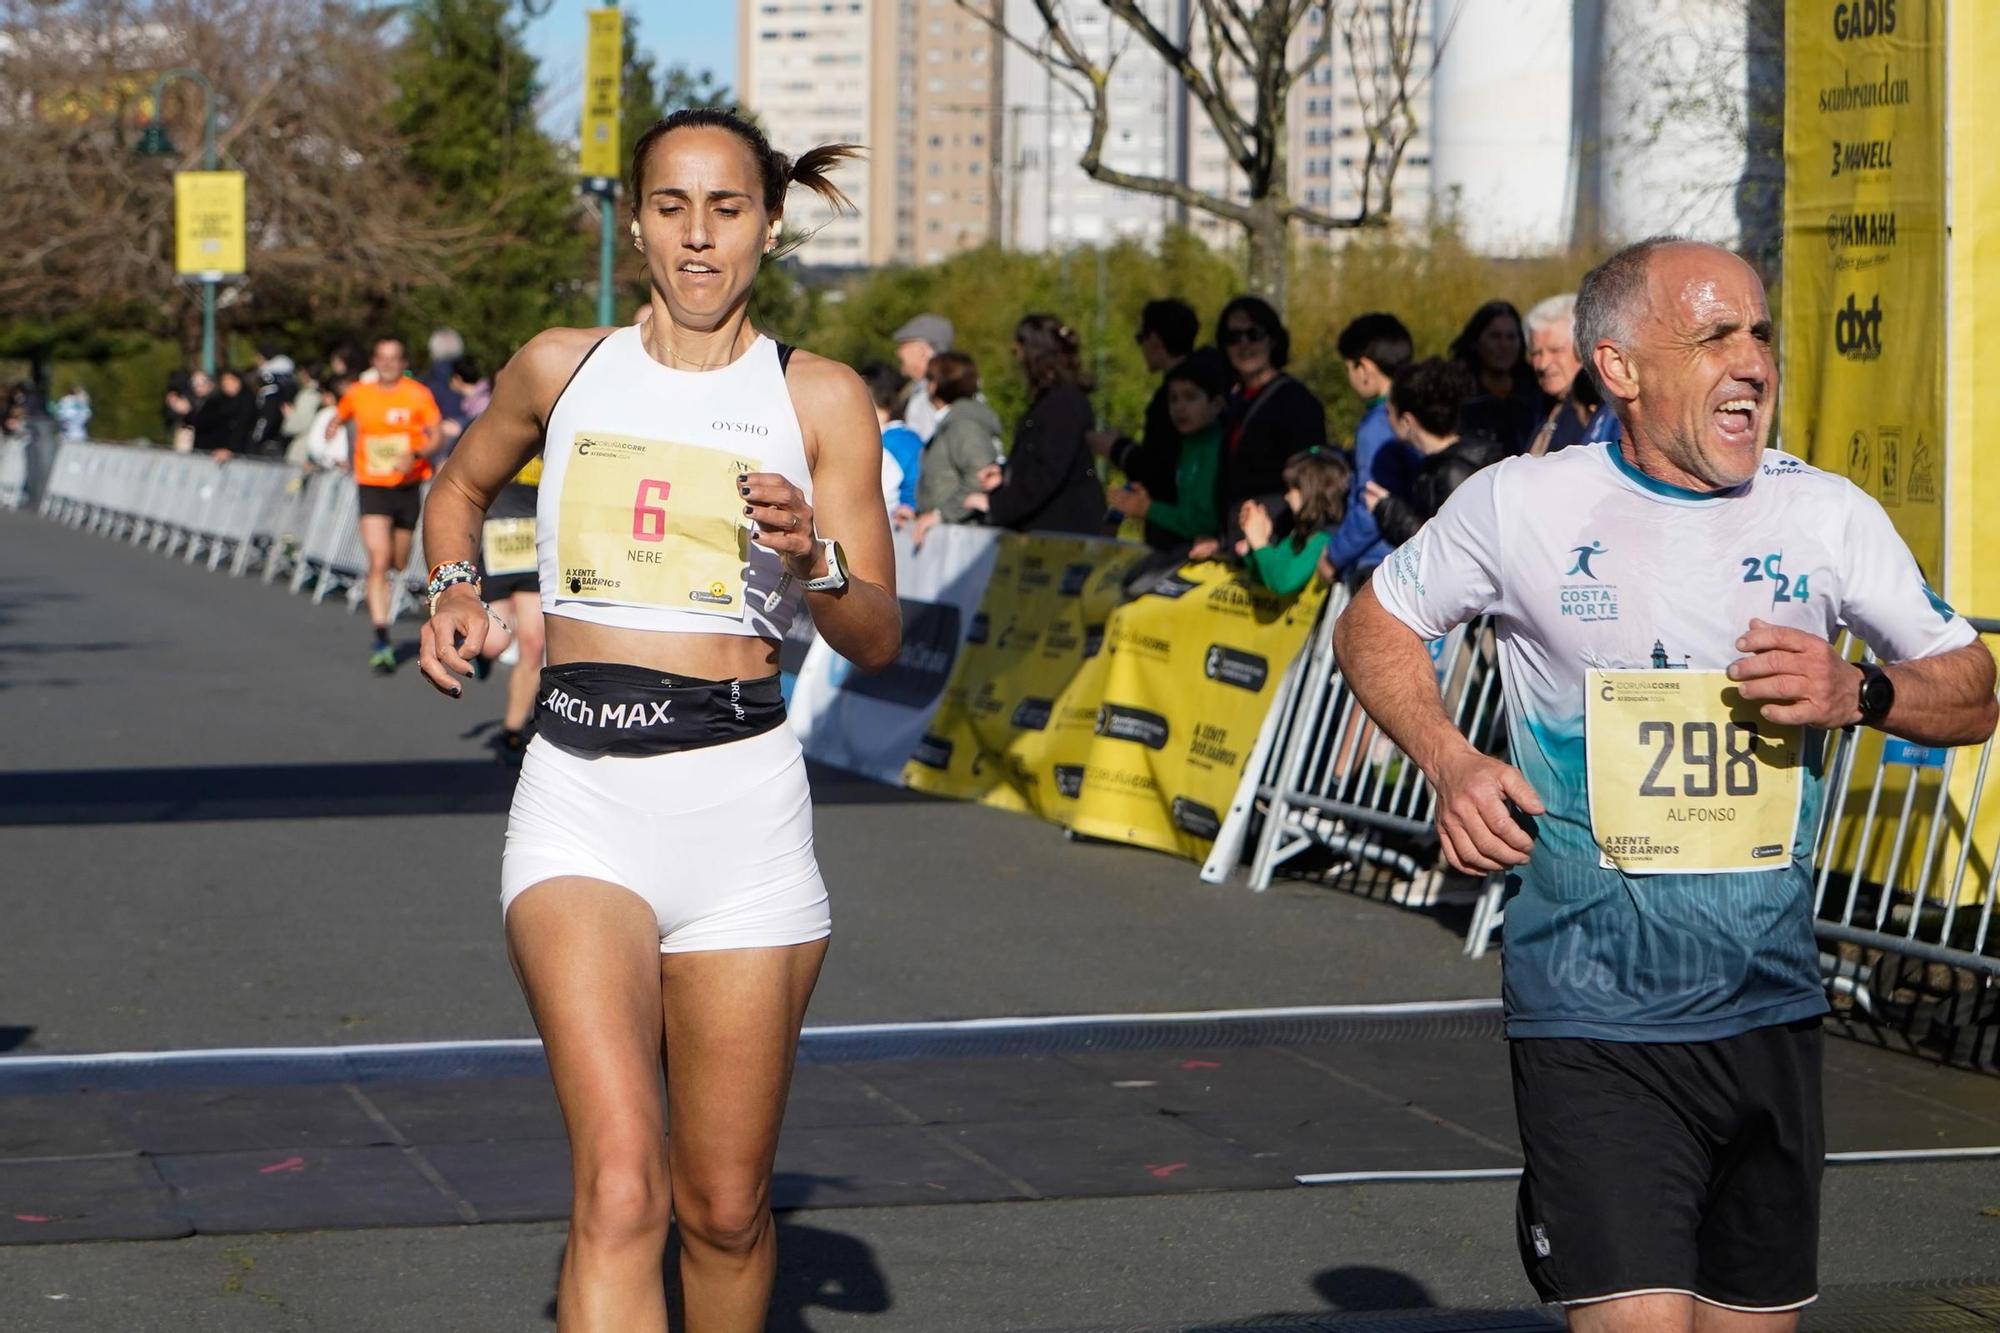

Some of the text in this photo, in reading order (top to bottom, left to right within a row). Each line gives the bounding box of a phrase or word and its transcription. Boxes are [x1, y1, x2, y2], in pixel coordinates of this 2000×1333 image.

[1833, 0, 1896, 42] GADIS
[1818, 63, 1910, 112] sanbrandan
[1839, 212, 1896, 246] YAMAHA
[1836, 291, 1883, 356] dxt
[711, 420, 769, 437] OYSHO
[633, 479, 671, 542] 6
[627, 550, 663, 564] NERE
[565, 568, 596, 578] A XENTE
[582, 577, 621, 589] BARRIOS
[1560, 590, 1611, 603] COSTA
[1561, 603, 1618, 617] MORTE
[541, 688, 672, 729] ARCh MAX
[1638, 721, 1759, 797] 298
[1666, 807, 1737, 822] ALFONSO
[1605, 836, 1651, 846] A XENTE
[1607, 845, 1681, 855] DOS BARRIOS
